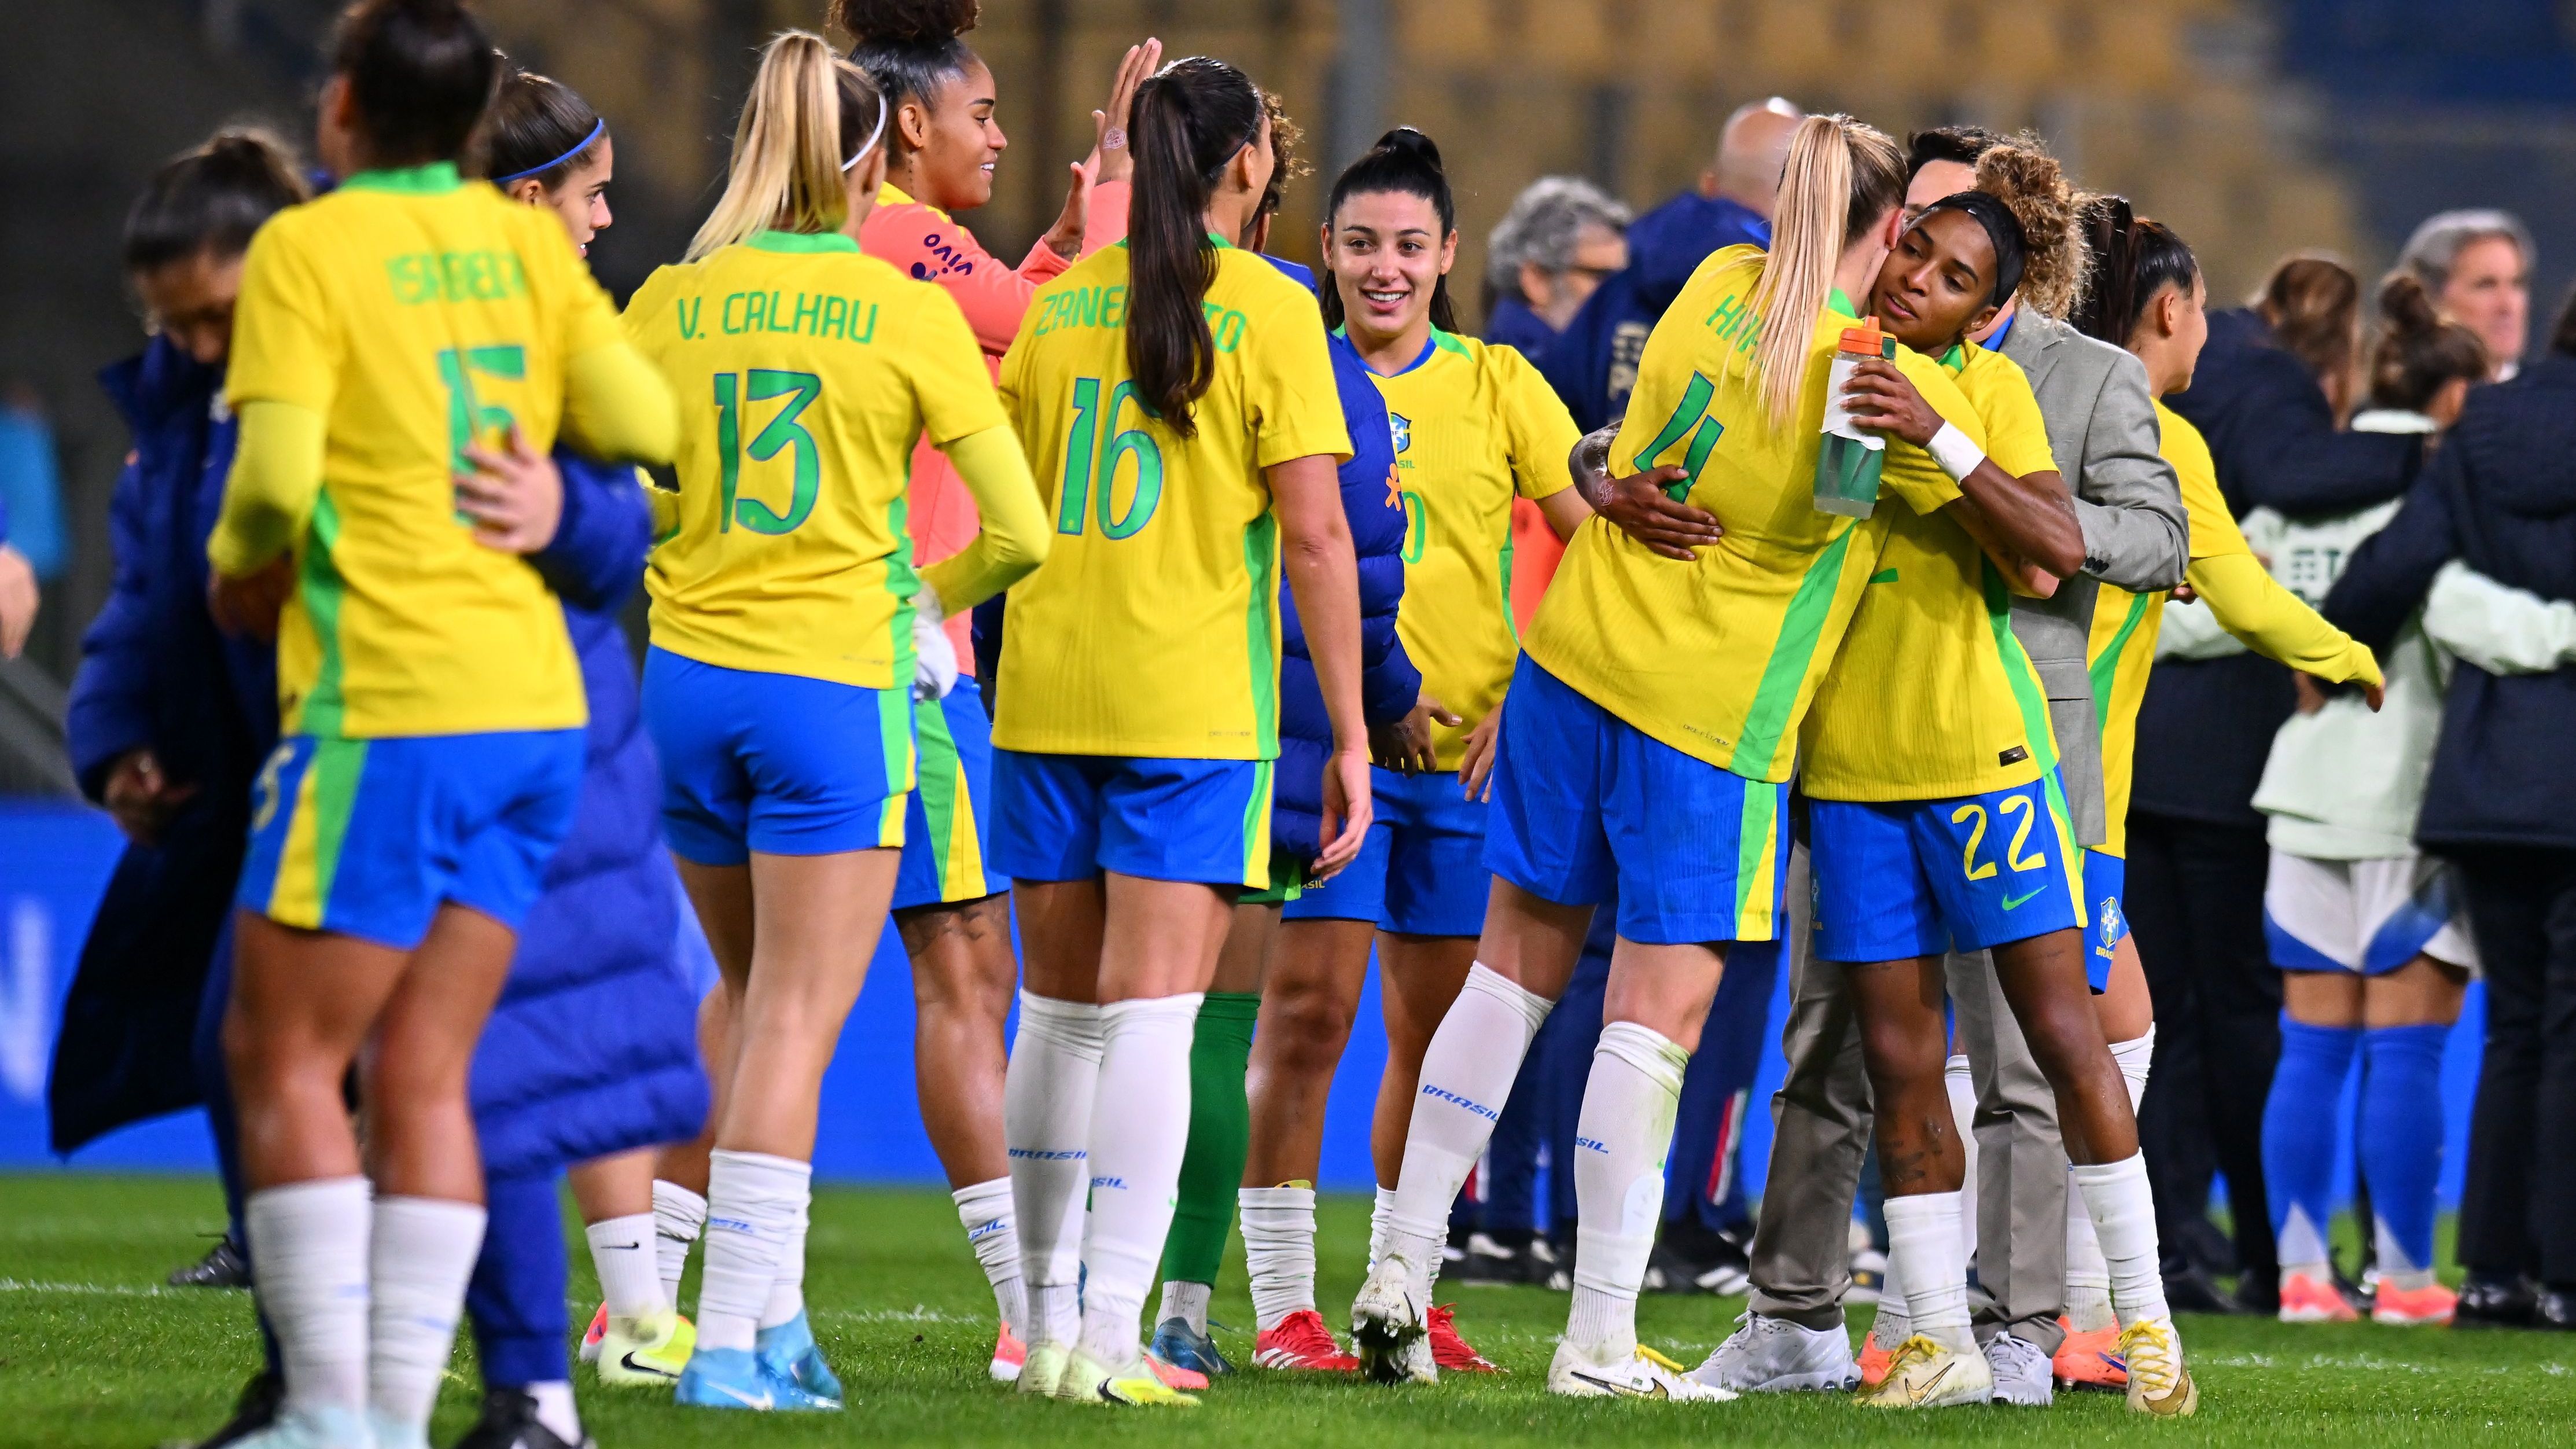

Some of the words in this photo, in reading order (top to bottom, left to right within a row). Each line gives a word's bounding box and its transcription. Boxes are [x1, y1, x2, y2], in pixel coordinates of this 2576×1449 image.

[923, 234, 973, 276] vivo
[678, 296, 706, 340] V.
[722, 290, 878, 345] CALHAU
[1033, 286, 1247, 354] ZANETO
[713, 369, 822, 536] 13
[1057, 377, 1164, 541] 16
[1397, 459, 1416, 469] SIL
[1633, 369, 1725, 505] 4
[1951, 795, 2047, 881] 22
[1301, 880, 1326, 889] ASIL
[1422, 1084, 1497, 1123] BRASIL
[1576, 1137, 1609, 1154] SIL
